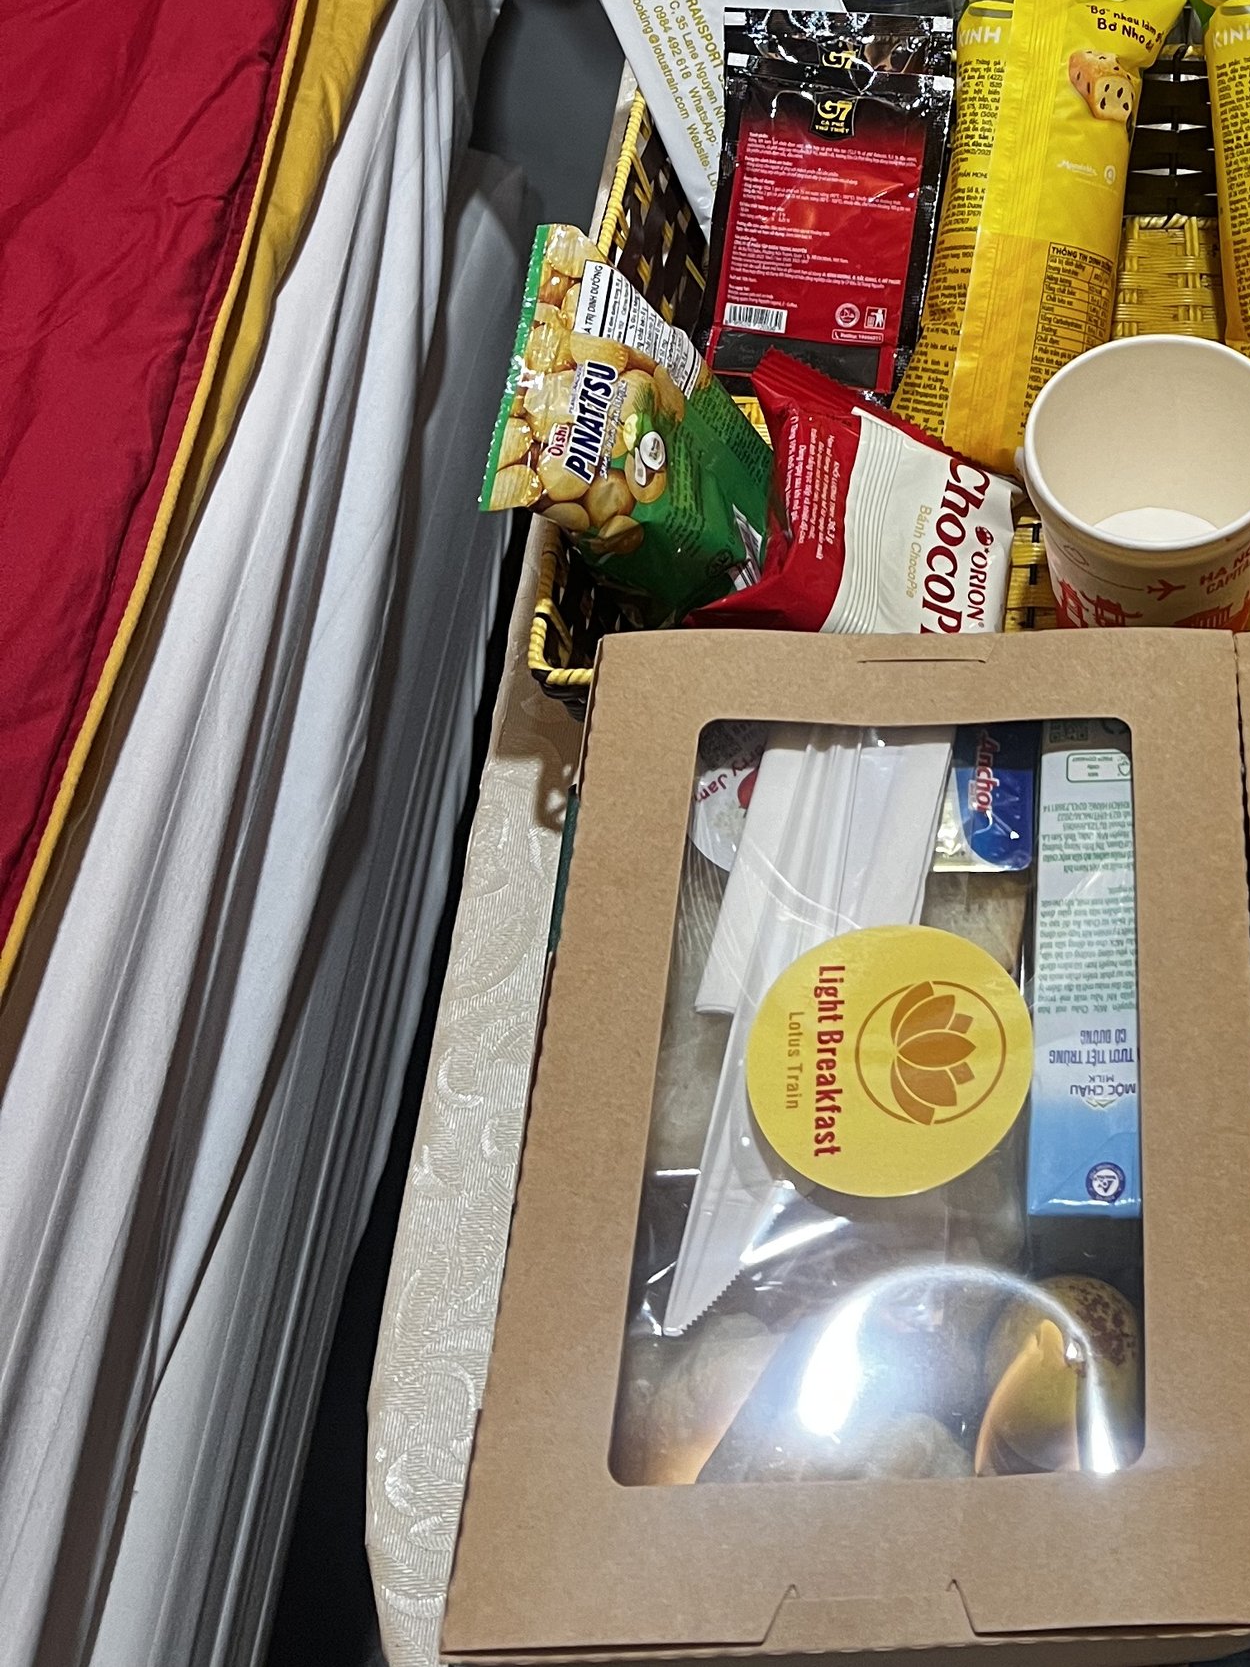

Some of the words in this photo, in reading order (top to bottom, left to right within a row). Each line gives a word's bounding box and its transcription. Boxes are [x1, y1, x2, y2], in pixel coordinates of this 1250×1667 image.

[675, 16, 690, 31] 35
[1097, 17, 1118, 32] Bơ
[1121, 24, 1146, 44] Nho
[1113, 12, 1140, 26] nhau
[682, 32, 699, 60] Lane
[653, 4, 674, 34] 0984
[667, 35, 683, 58] 492
[675, 57, 693, 80] 618
[688, 86, 719, 147] WhatsApp:
[694, 61, 718, 105] Nguyen
[817, 99, 854, 121] G7
[686, 122, 712, 172] Website:
[1051, 246, 1078, 259] THÔNG
[563, 360, 619, 485] PINATTSU
[547, 423, 571, 458] Oishi
[913, 504, 933, 538] Bánh
[920, 458, 991, 634] ChocoP
[906, 541, 923, 599] ChocoPie
[966, 550, 988, 626] ORION
[975, 728, 1000, 813] Anchor
[813, 965, 846, 1024] Light
[787, 1011, 805, 1057] Lotus
[1080, 1029, 1111, 1046] ĐƯỜNG
[1113, 1028, 1127, 1047] CÓ
[1049, 1049, 1084, 1065] TRÙNG
[1085, 1049, 1107, 1067] TIỆT
[785, 1065, 803, 1110] Train
[813, 1029, 845, 1158] Breakfast
[1070, 1083, 1103, 1097] CHÂU
[1088, 1074, 1115, 1083] MILK
[1115, 1083, 1137, 1098] MỘC
